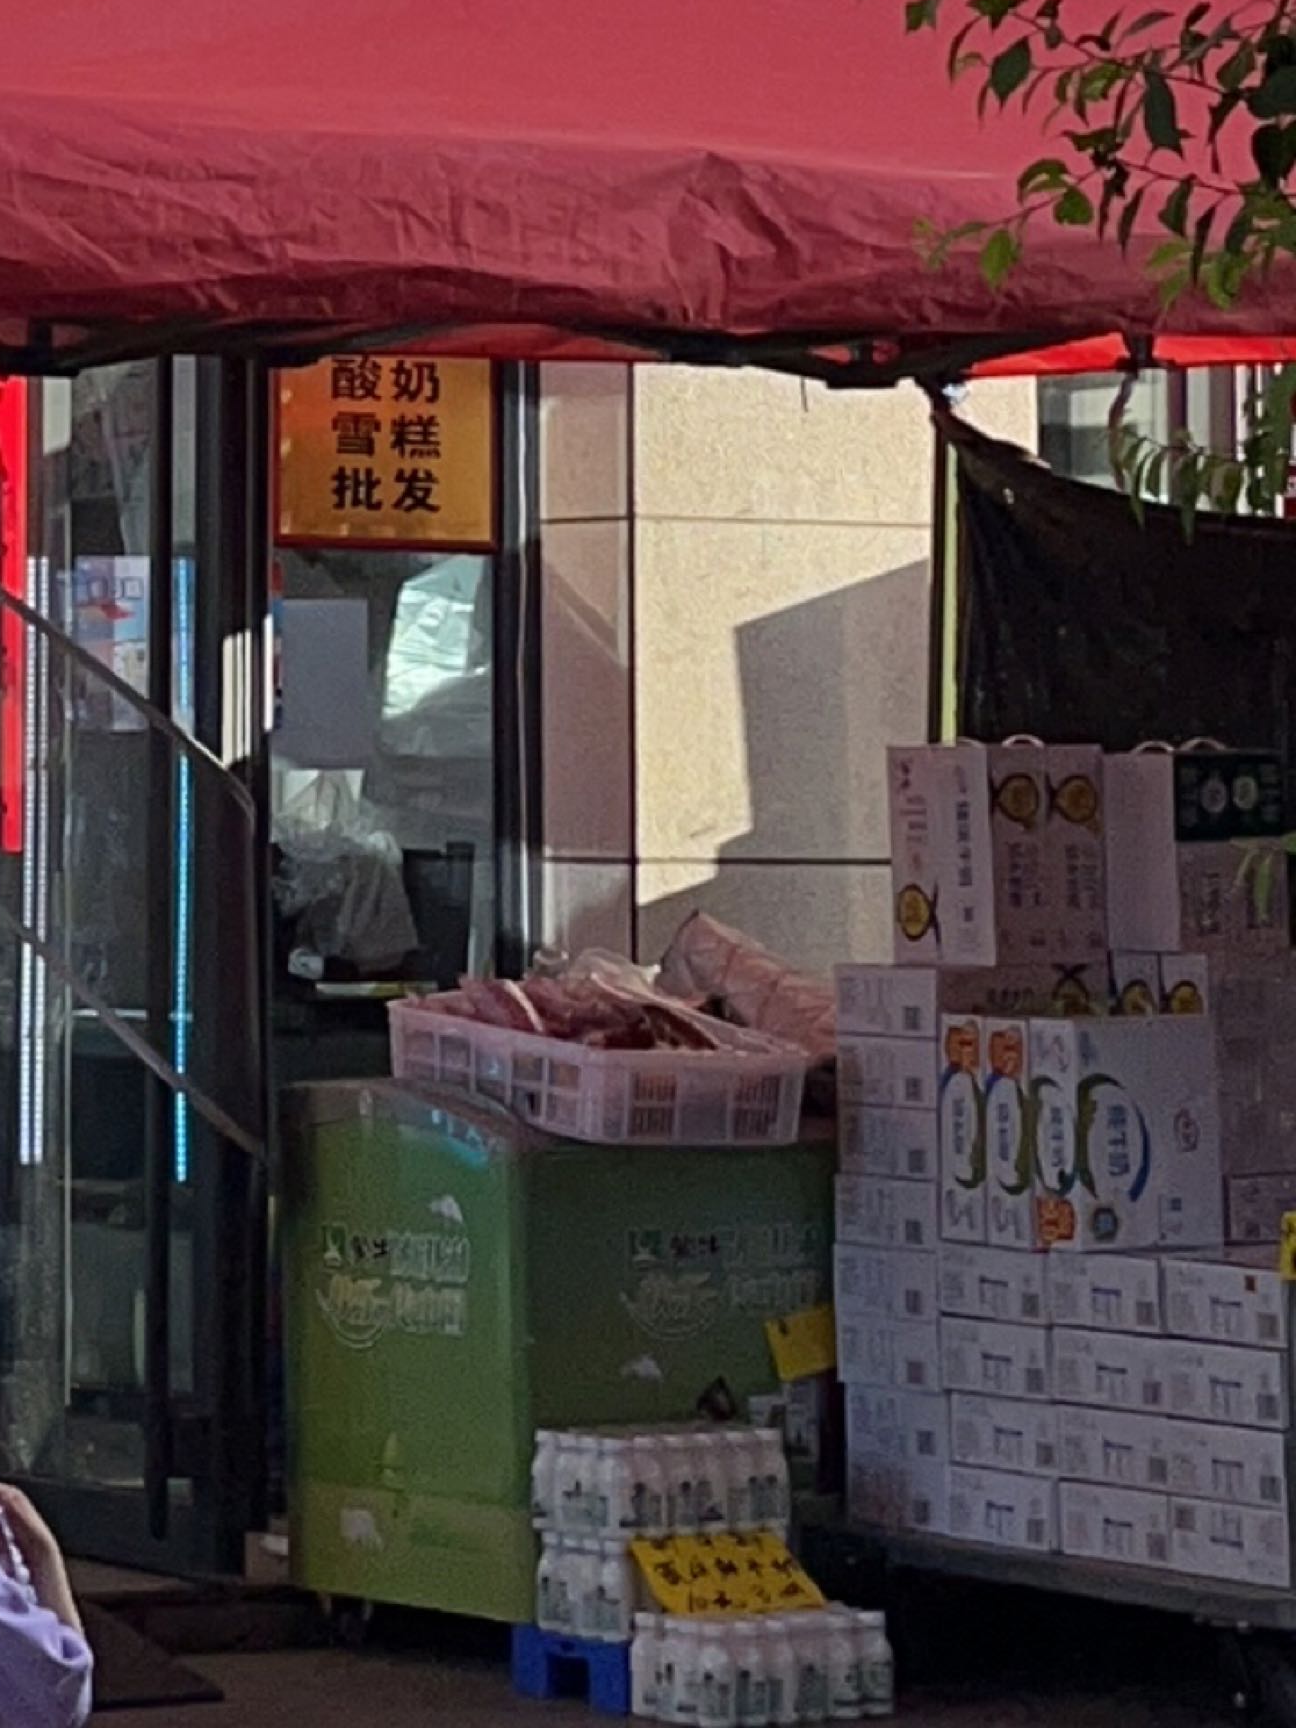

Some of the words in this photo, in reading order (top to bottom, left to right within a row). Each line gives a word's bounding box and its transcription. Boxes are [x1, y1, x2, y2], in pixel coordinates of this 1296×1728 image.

[330, 355, 440, 403] 酸奶
[330, 411, 441, 460] 雪糕
[330, 466, 441, 513] 批发
